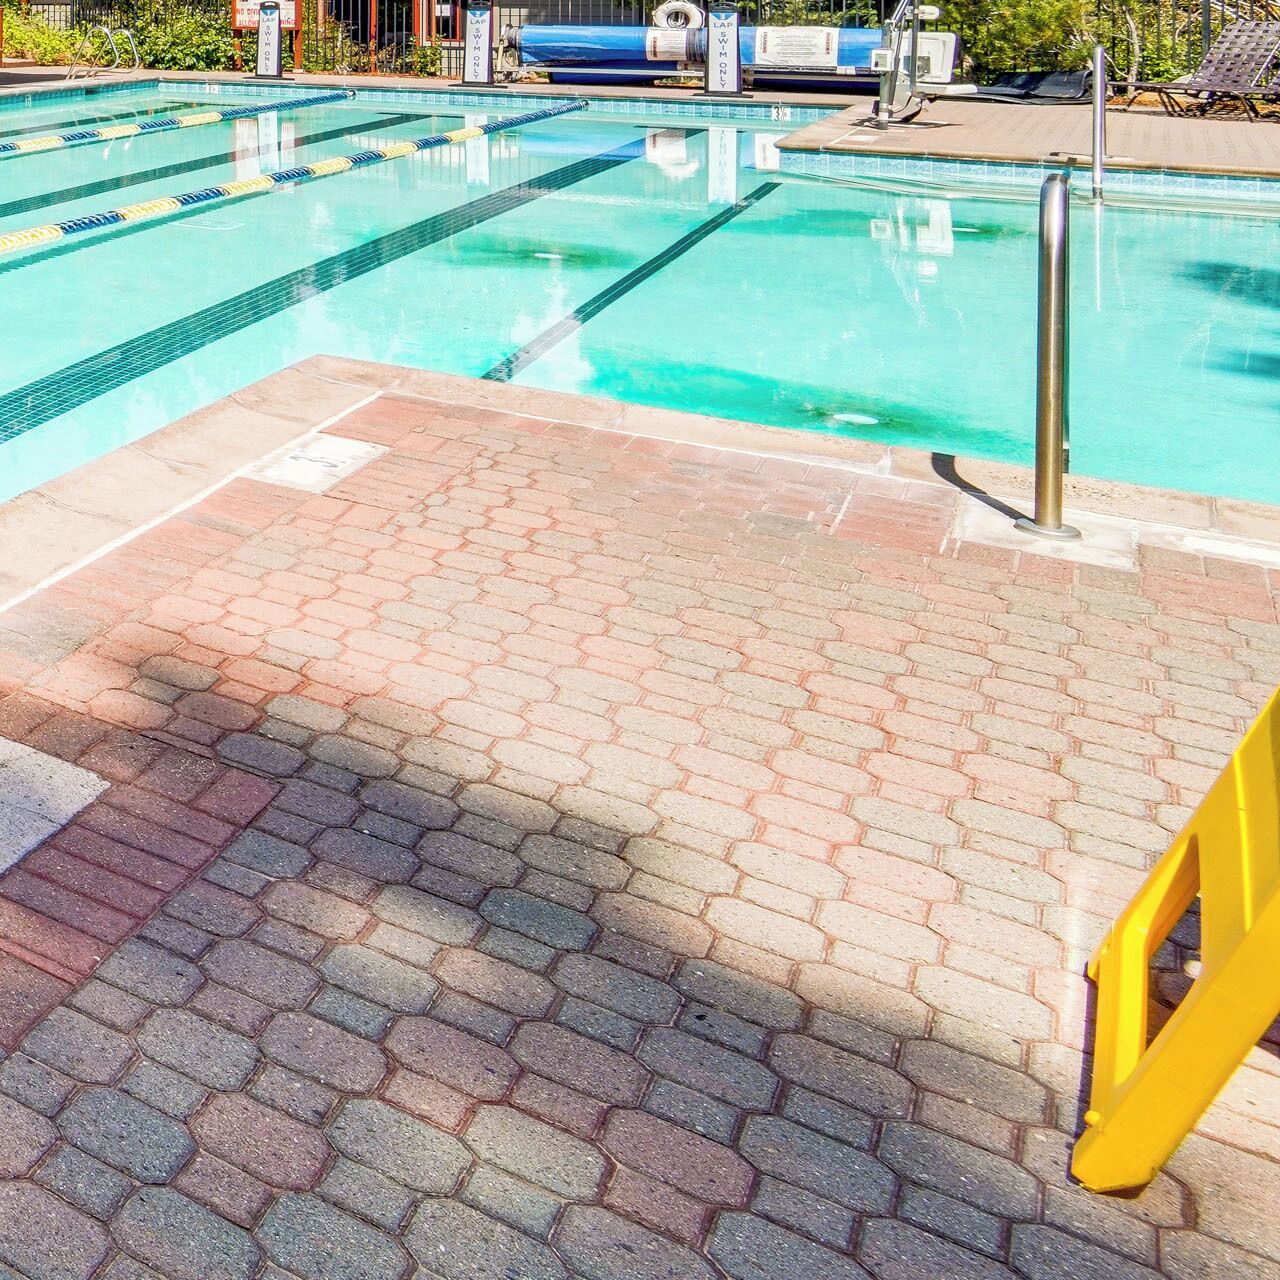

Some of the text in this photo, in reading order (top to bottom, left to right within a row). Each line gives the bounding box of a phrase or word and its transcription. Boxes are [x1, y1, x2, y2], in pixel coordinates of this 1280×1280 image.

[264, 25, 272, 47] SWIM
[473, 28, 482, 52] SWIM
[718, 32, 728, 88] SWIM ONLY
